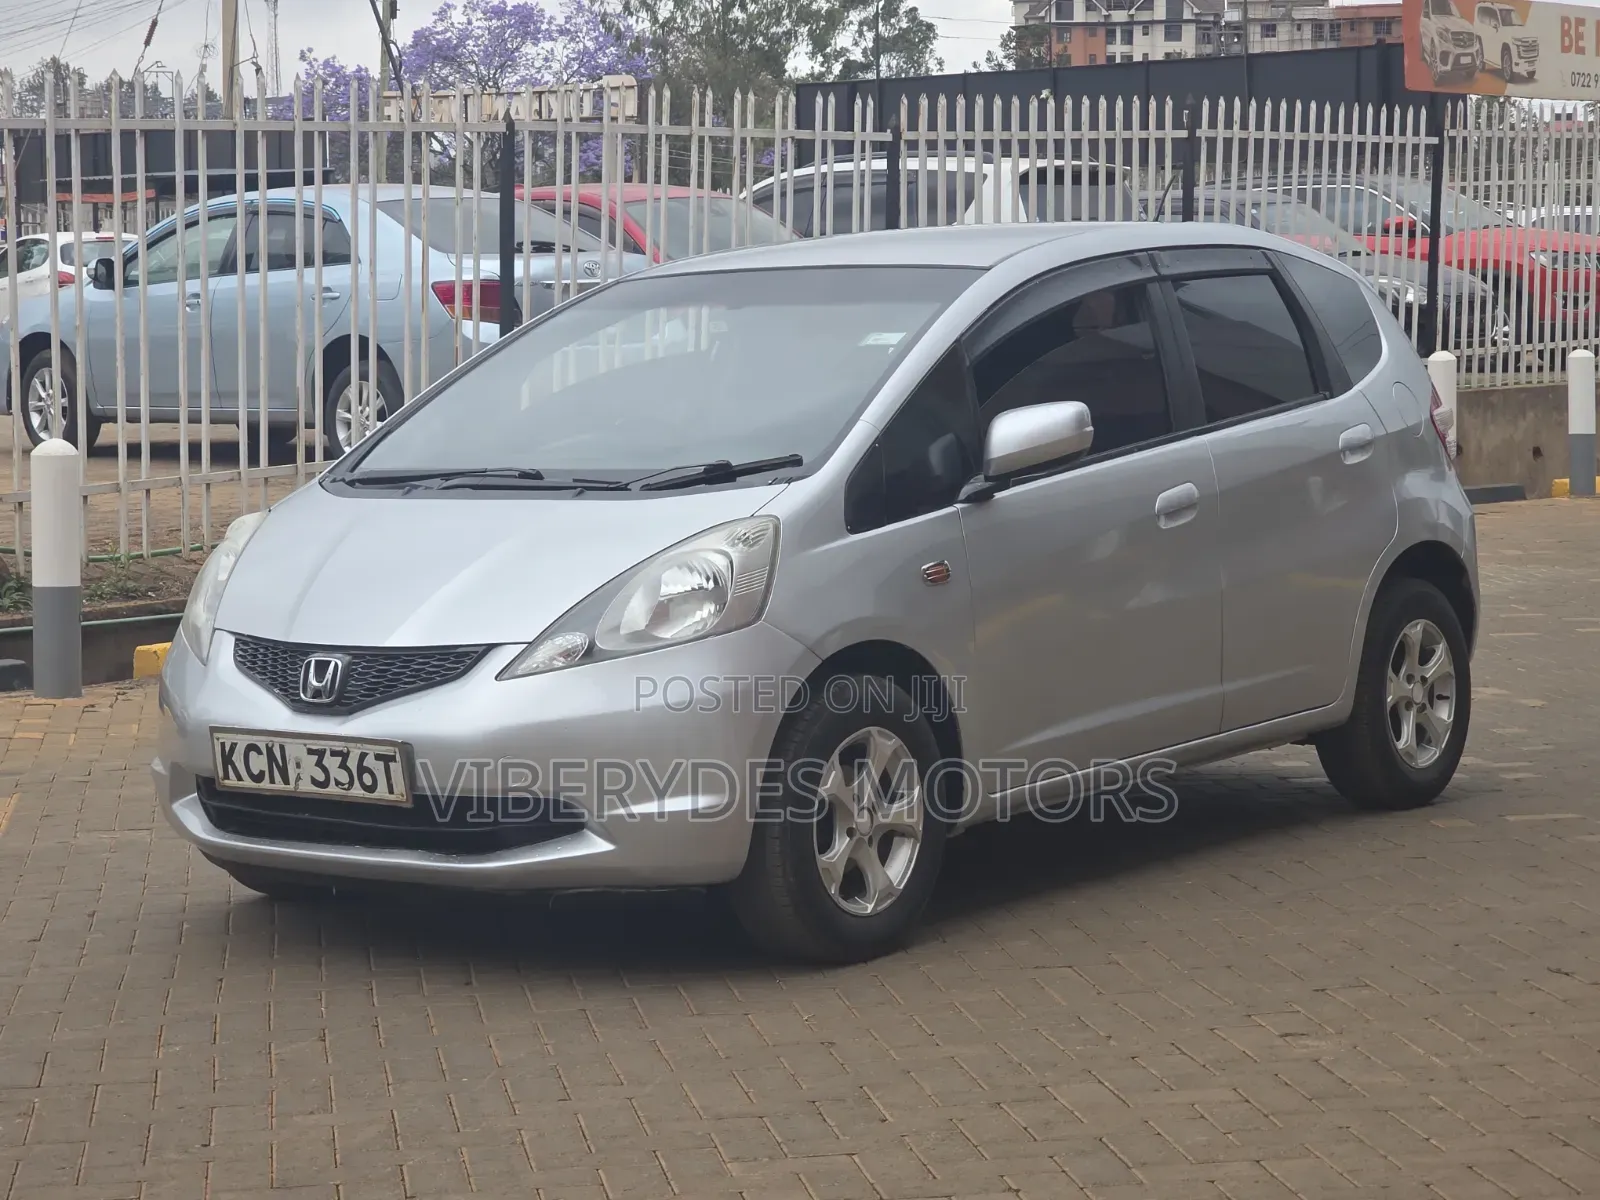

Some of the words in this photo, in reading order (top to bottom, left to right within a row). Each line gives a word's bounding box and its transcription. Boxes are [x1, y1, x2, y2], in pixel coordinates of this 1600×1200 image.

[1561, 15, 1586, 55] BE
[1570, 71, 1592, 88] 0722
[220, 741, 291, 786] KCN
[306, 747, 398, 795] 336T
